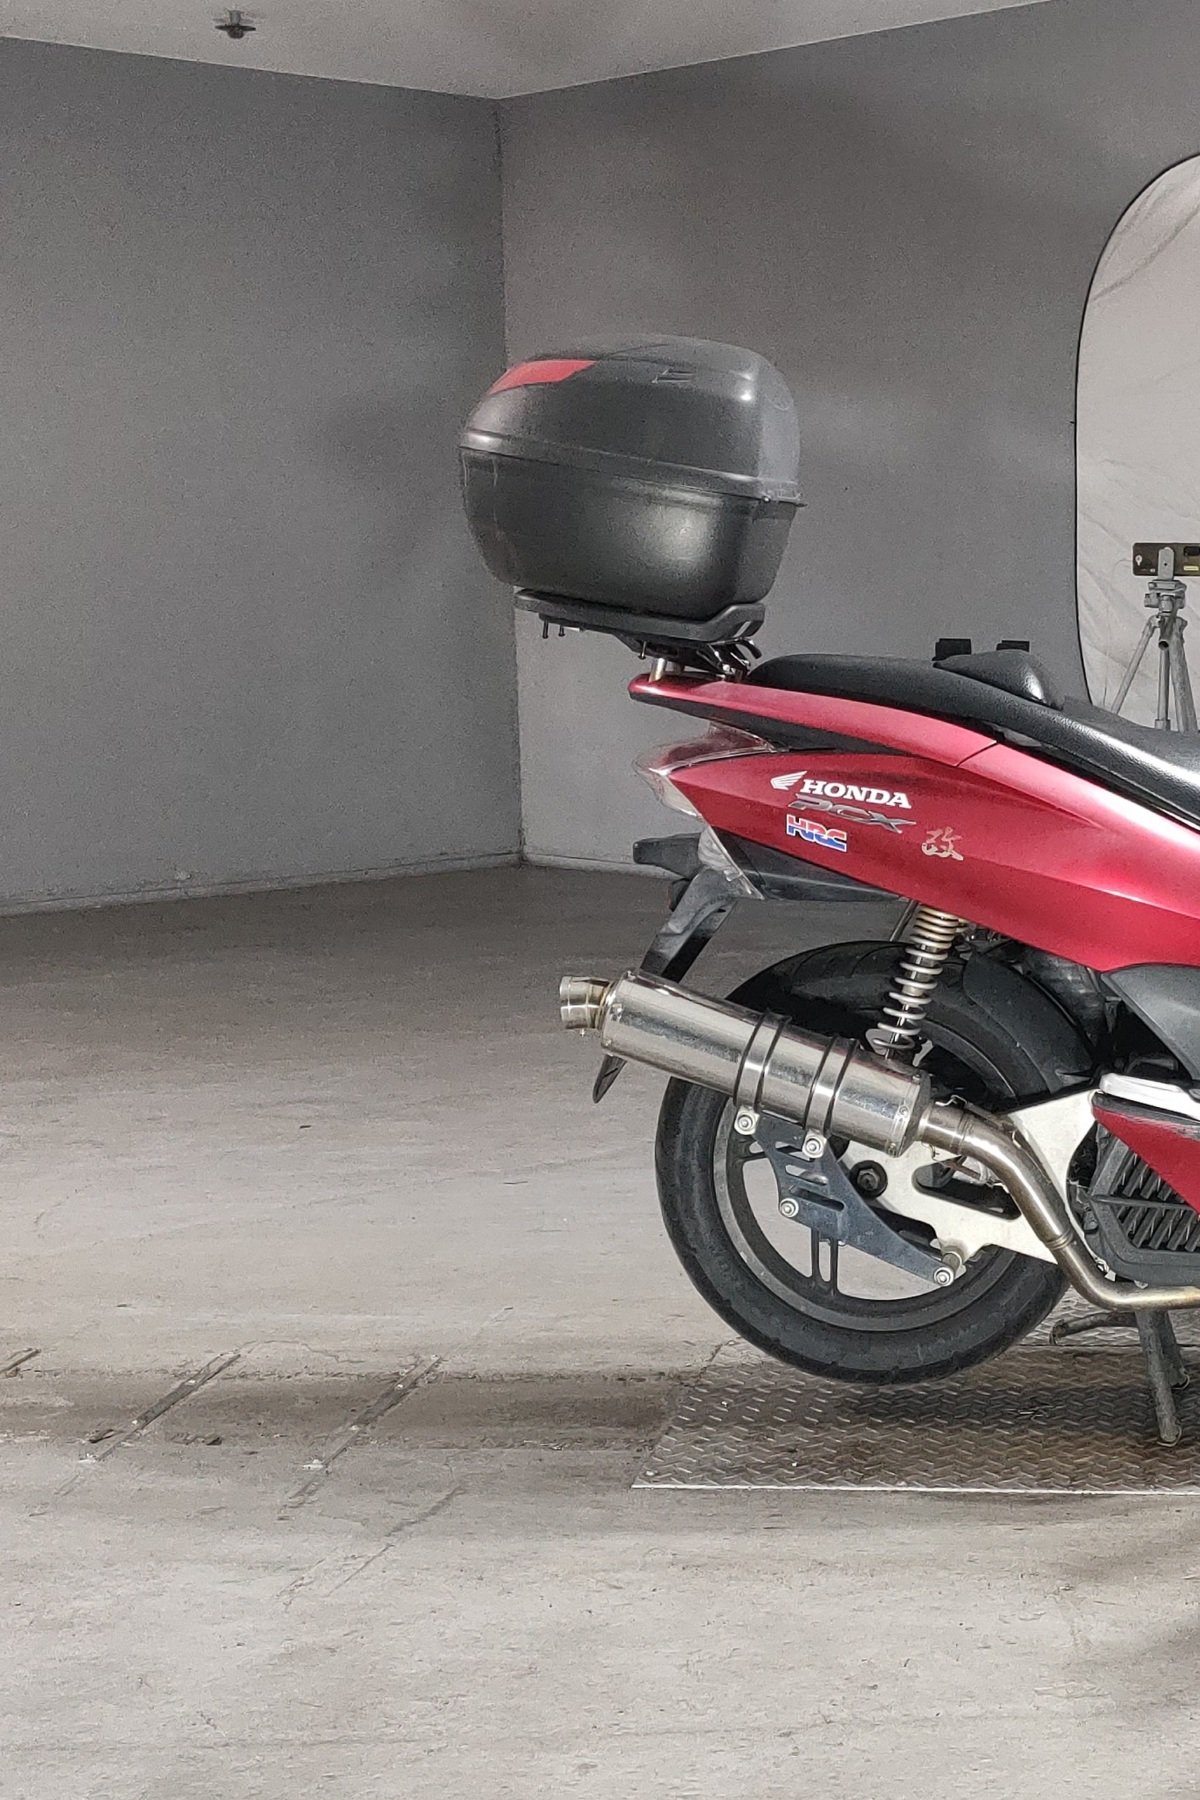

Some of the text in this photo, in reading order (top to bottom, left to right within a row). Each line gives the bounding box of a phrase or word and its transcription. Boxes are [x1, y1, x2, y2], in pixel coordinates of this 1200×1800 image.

[788, 793, 917, 834] PCX
[800, 778, 912, 809] HONDA
[786, 813, 848, 853] HRC
